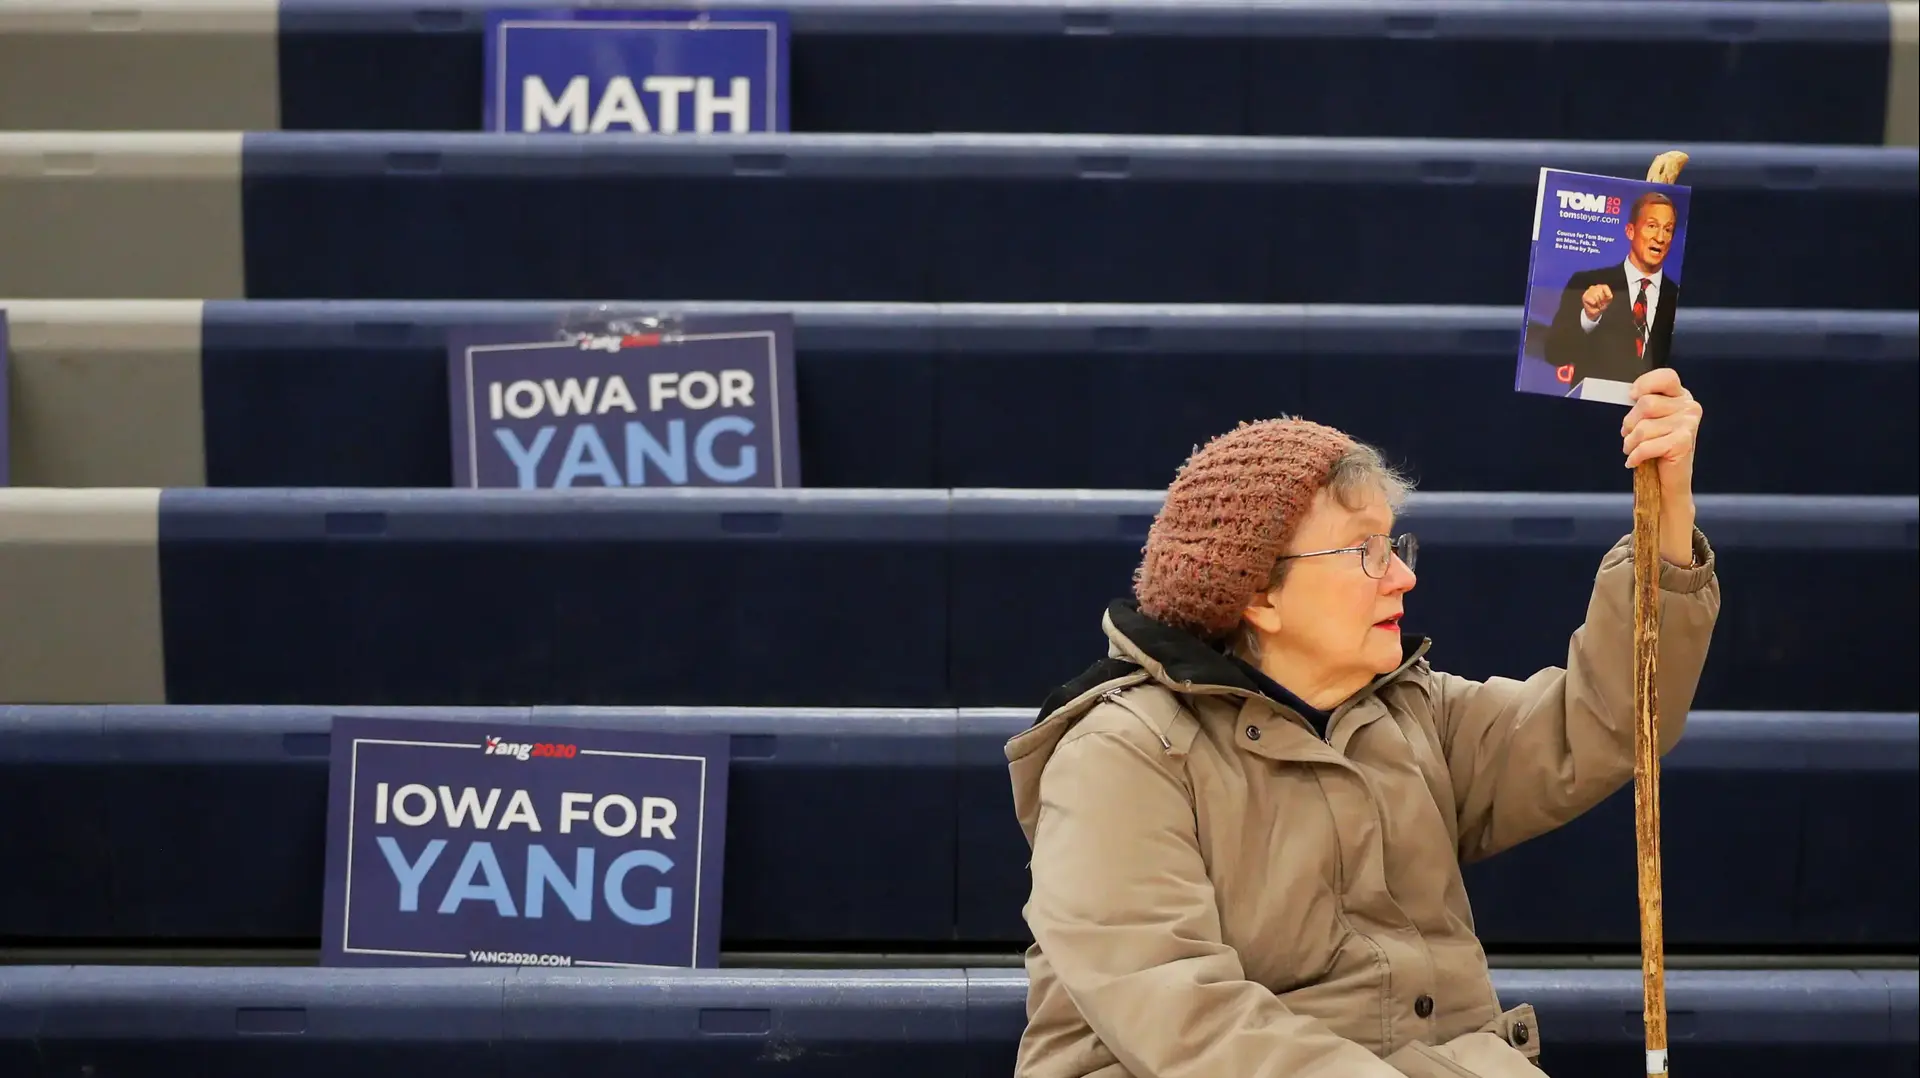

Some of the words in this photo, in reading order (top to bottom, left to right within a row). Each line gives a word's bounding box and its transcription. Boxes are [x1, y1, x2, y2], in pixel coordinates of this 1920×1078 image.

[523, 76, 750, 133] MATH
[1557, 190, 1606, 213] TOM
[1559, 210, 1620, 224] tomsteyer.com
[1597, 235, 1615, 243] Steyer
[489, 375, 637, 420] IOWA
[648, 369, 755, 412] FOR
[494, 415, 757, 488] YANG
[485, 735, 577, 760] Yang2020
[375, 783, 542, 832] IOWA
[559, 792, 678, 840] FOR
[376, 836, 675, 926] YANG
[469, 950, 571, 966] YANG2020.COM
